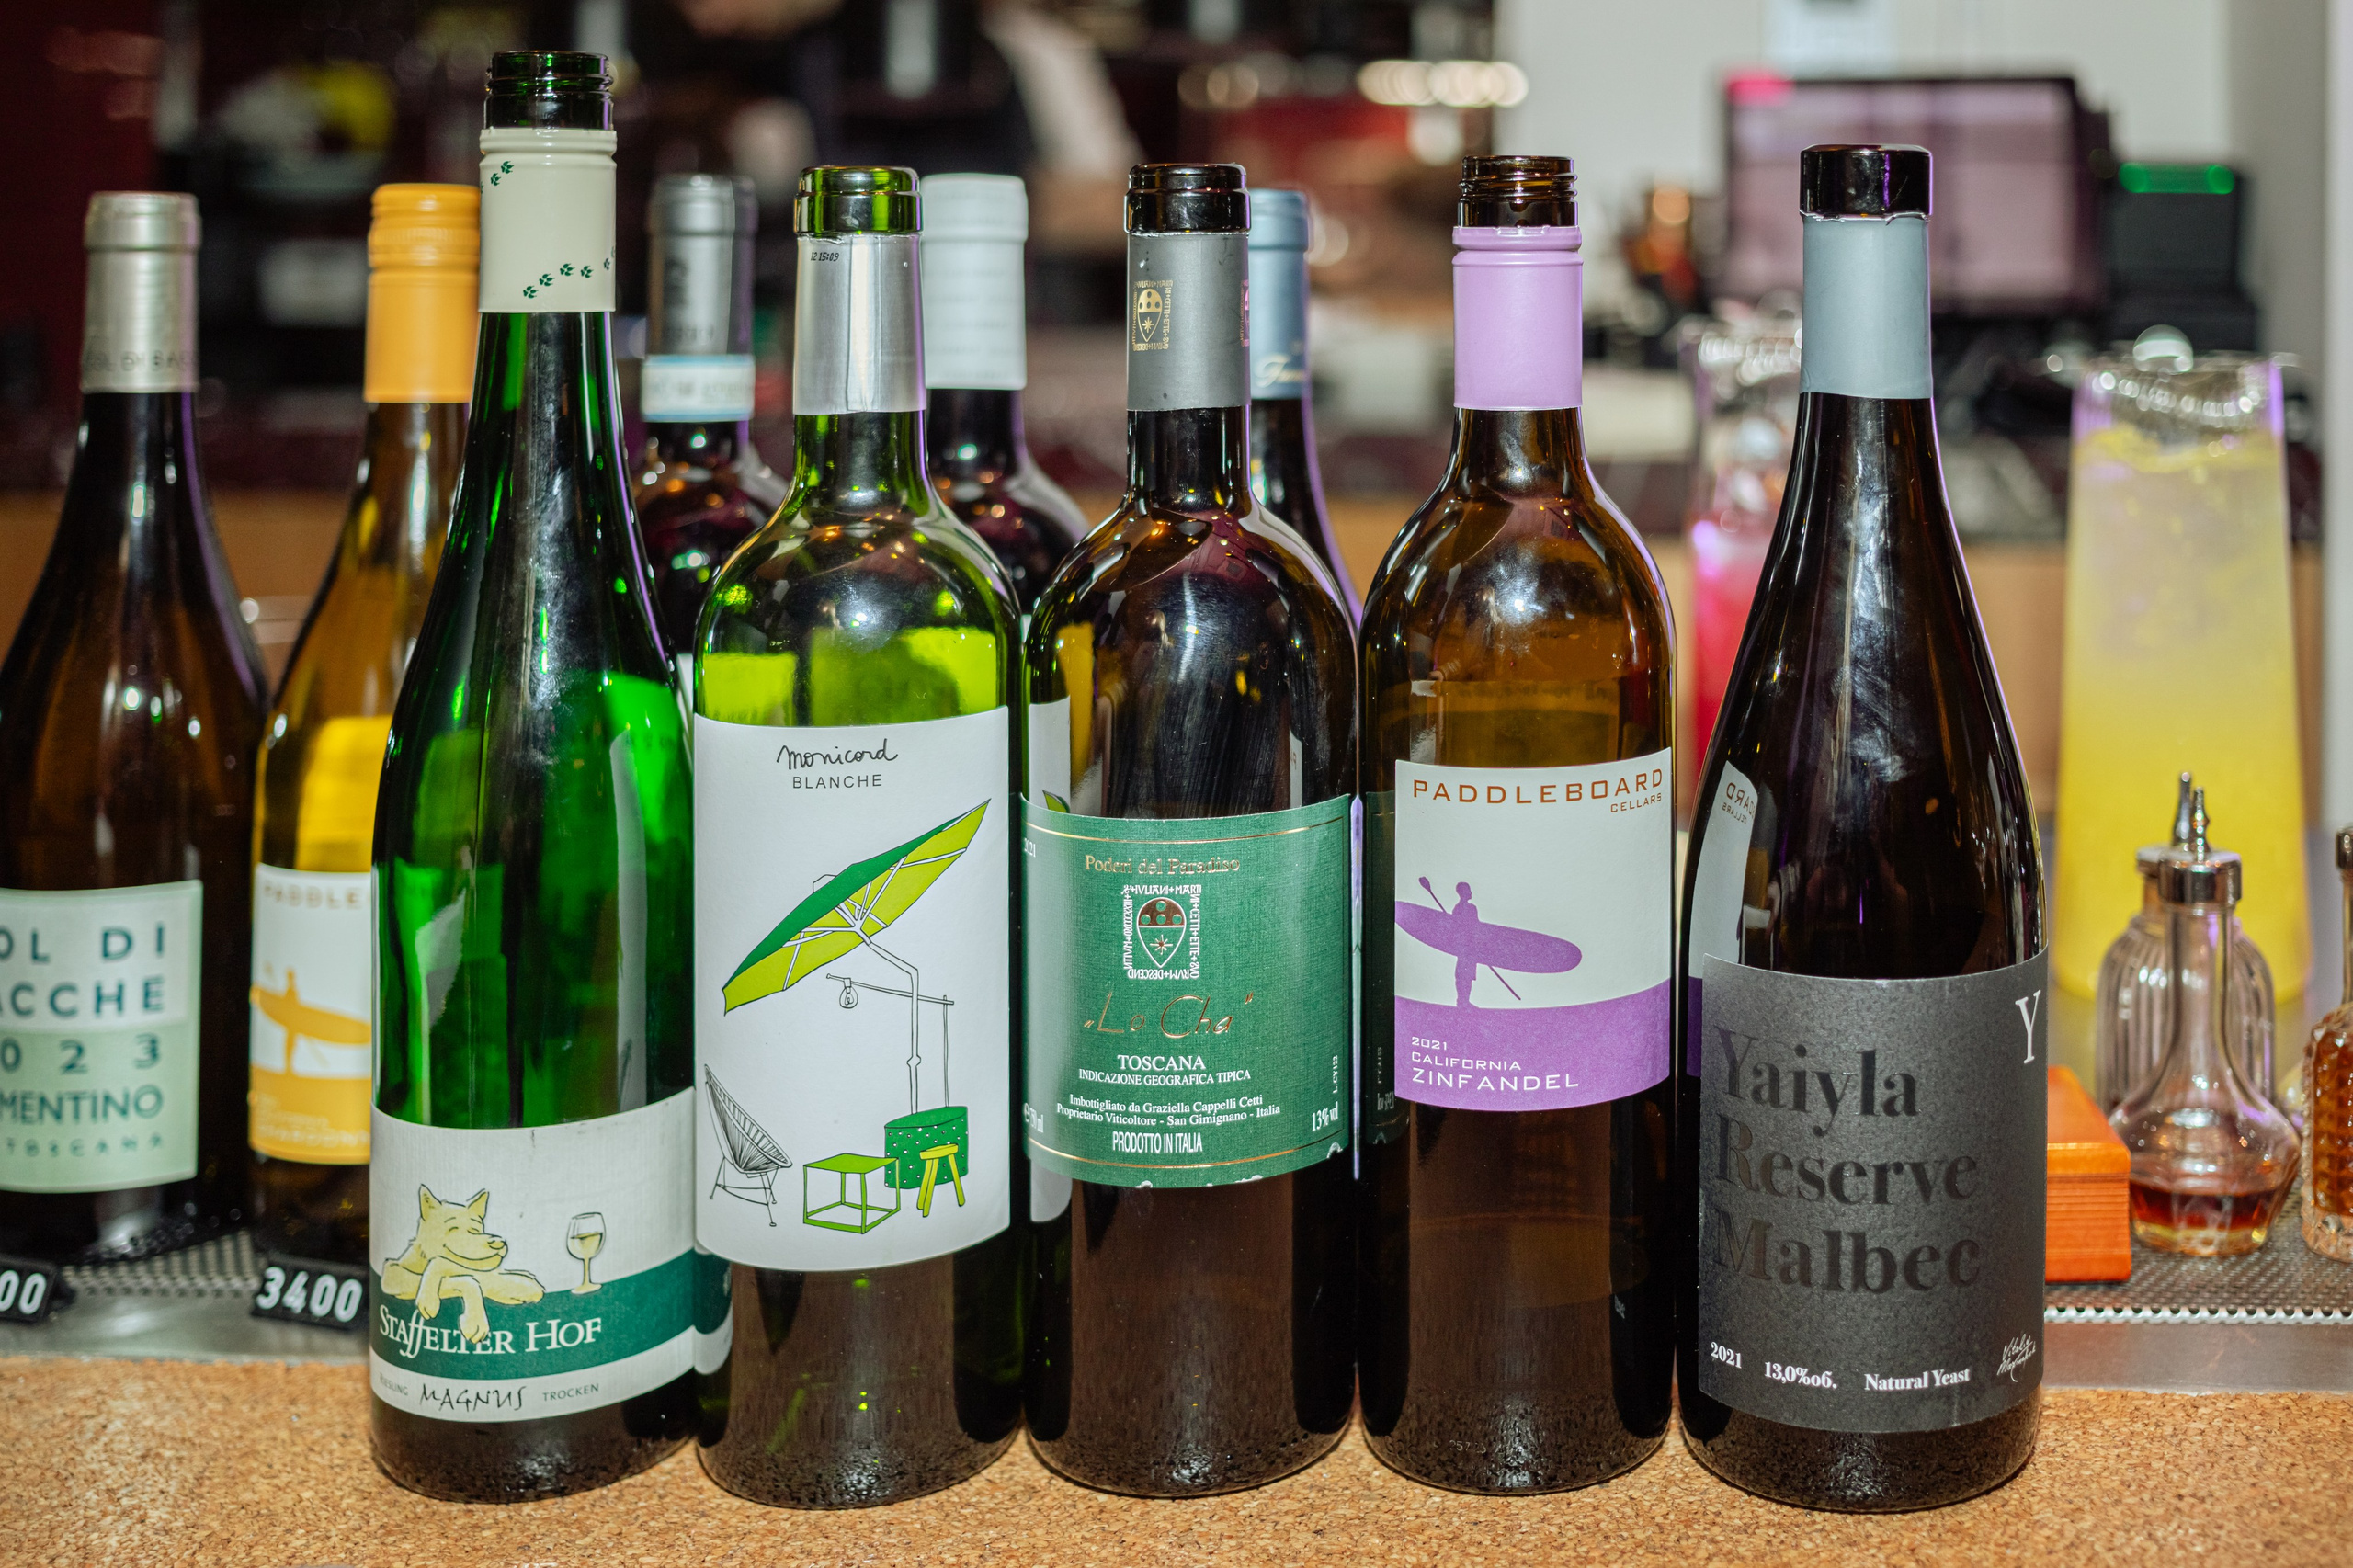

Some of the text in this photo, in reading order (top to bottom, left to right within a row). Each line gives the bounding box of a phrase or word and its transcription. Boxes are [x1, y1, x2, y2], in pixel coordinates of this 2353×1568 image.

[818, 252, 840, 262] 15:09
[792, 774, 882, 789] BLANCHE
[1413, 768, 1664, 804] PADDLEBOARD
[1610, 792, 1663, 813] CELLARS
[1085, 855, 1241, 875] Poderi del Paradiso
[101, 921, 164, 961] DI
[0, 975, 164, 1019] CCHE
[2015, 989, 2041, 1064] Y
[1412, 1036, 1448, 1051] 2021
[1117, 1054, 1207, 1071] TOSCANA
[1412, 1051, 1522, 1071] CALIFORNIA
[1079, 1068, 1251, 1085] INDICAZIONE GEOGRAFICA TIPICA
[1412, 1066, 1579, 1092] ZINFANDEL
[1713, 1024, 1921, 1137] Yaiyla
[1057, 1102, 1104, 1122] Proprietario
[1105, 1112, 1157, 1126] Viticoltore
[1166, 1115, 1187, 1126] San
[1188, 1111, 1247, 1126] Gimignano
[1256, 1104, 1281, 1118] Italia
[1070, 1094, 1264, 1115] Imbottigliato da Graziella Cappelli Cetti
[1112, 1131, 1203, 1153] PRODOTTO IN ITALIA
[1715, 1113, 1978, 1205] Reserve
[1713, 1207, 1980, 1294] Malbec
[0, 1269, 47, 1315] 00
[256, 1266, 363, 1322] 3400
[525, 1317, 602, 1353] HOF
[1711, 1341, 1743, 1369] 2021
[1864, 1371, 1929, 1392] Natural
[1931, 1367, 1972, 1388] Yeast
[419, 1382, 528, 1413] MAGNUS
[542, 1382, 600, 1403] TROCKEN
